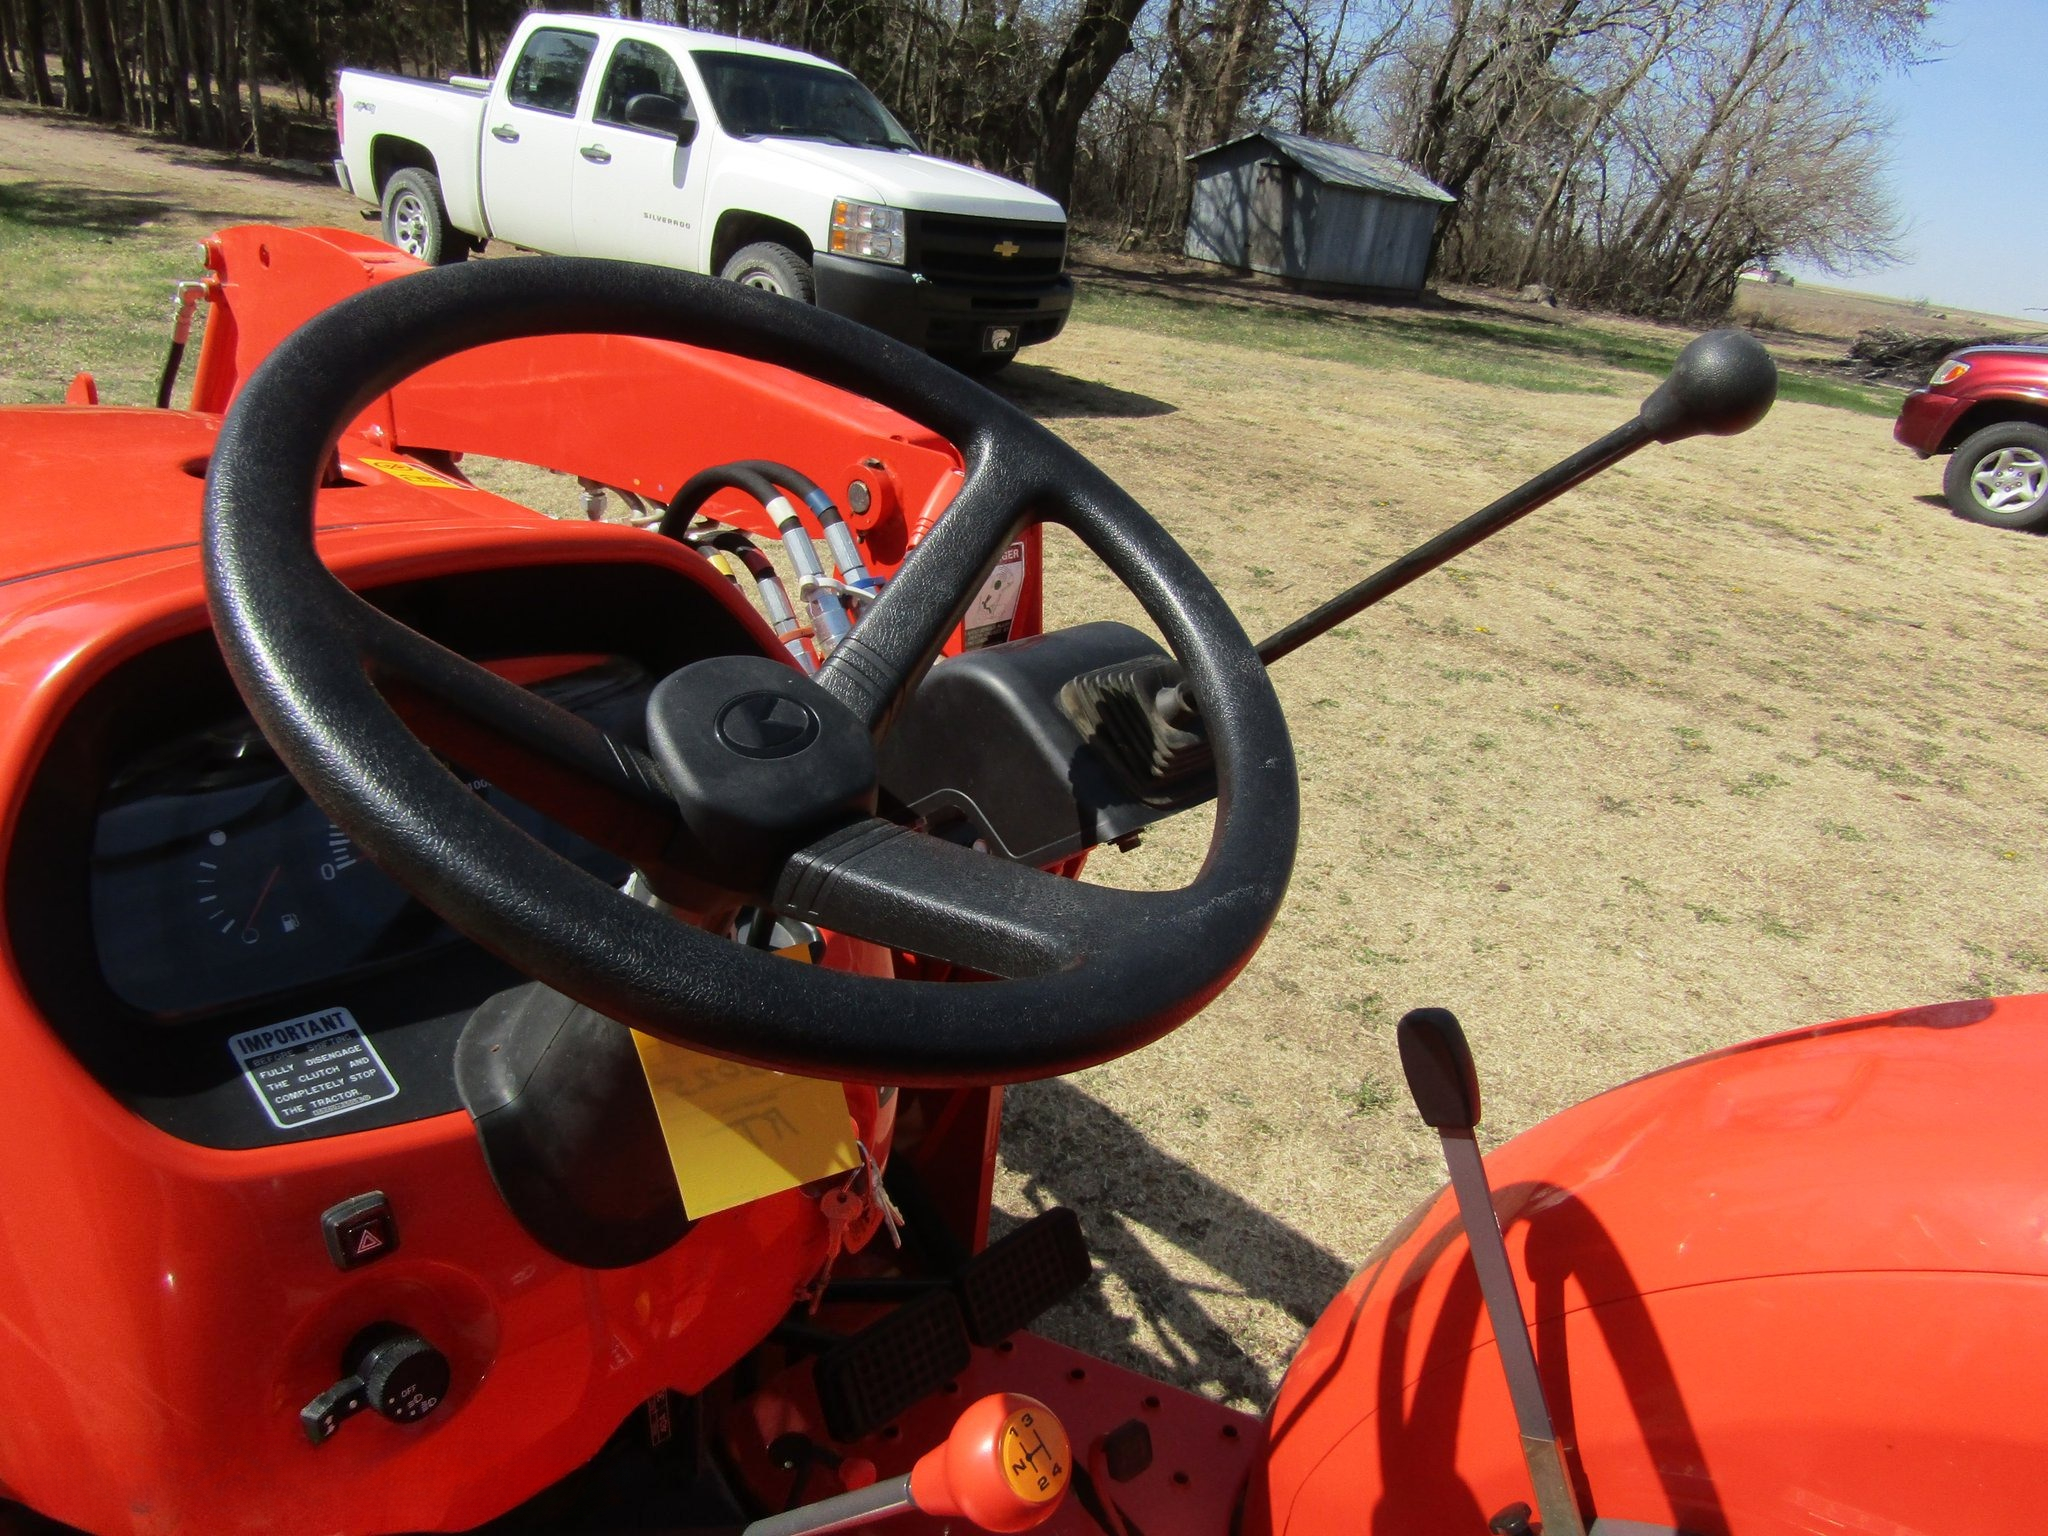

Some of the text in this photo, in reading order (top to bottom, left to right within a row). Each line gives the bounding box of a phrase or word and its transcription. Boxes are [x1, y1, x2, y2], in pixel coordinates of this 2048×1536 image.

[643, 212, 691, 229] SILVERADO
[237, 1012, 347, 1054] IMPORTANT
[252, 1050, 296, 1067] BEFORE
[259, 1044, 362, 1080] FULLY DISENGAGE
[266, 1056, 370, 1091] THE CLUTCH AND
[274, 1068, 377, 1104] COMPLETELY STOP
[281, 1103, 306, 1117] THE
[310, 1088, 363, 1108] TRACTOR.
[401, 1384, 417, 1398] OFF
[1009, 1412, 1034, 1437] 1 3
[1037, 1462, 1063, 1492] 2 4
